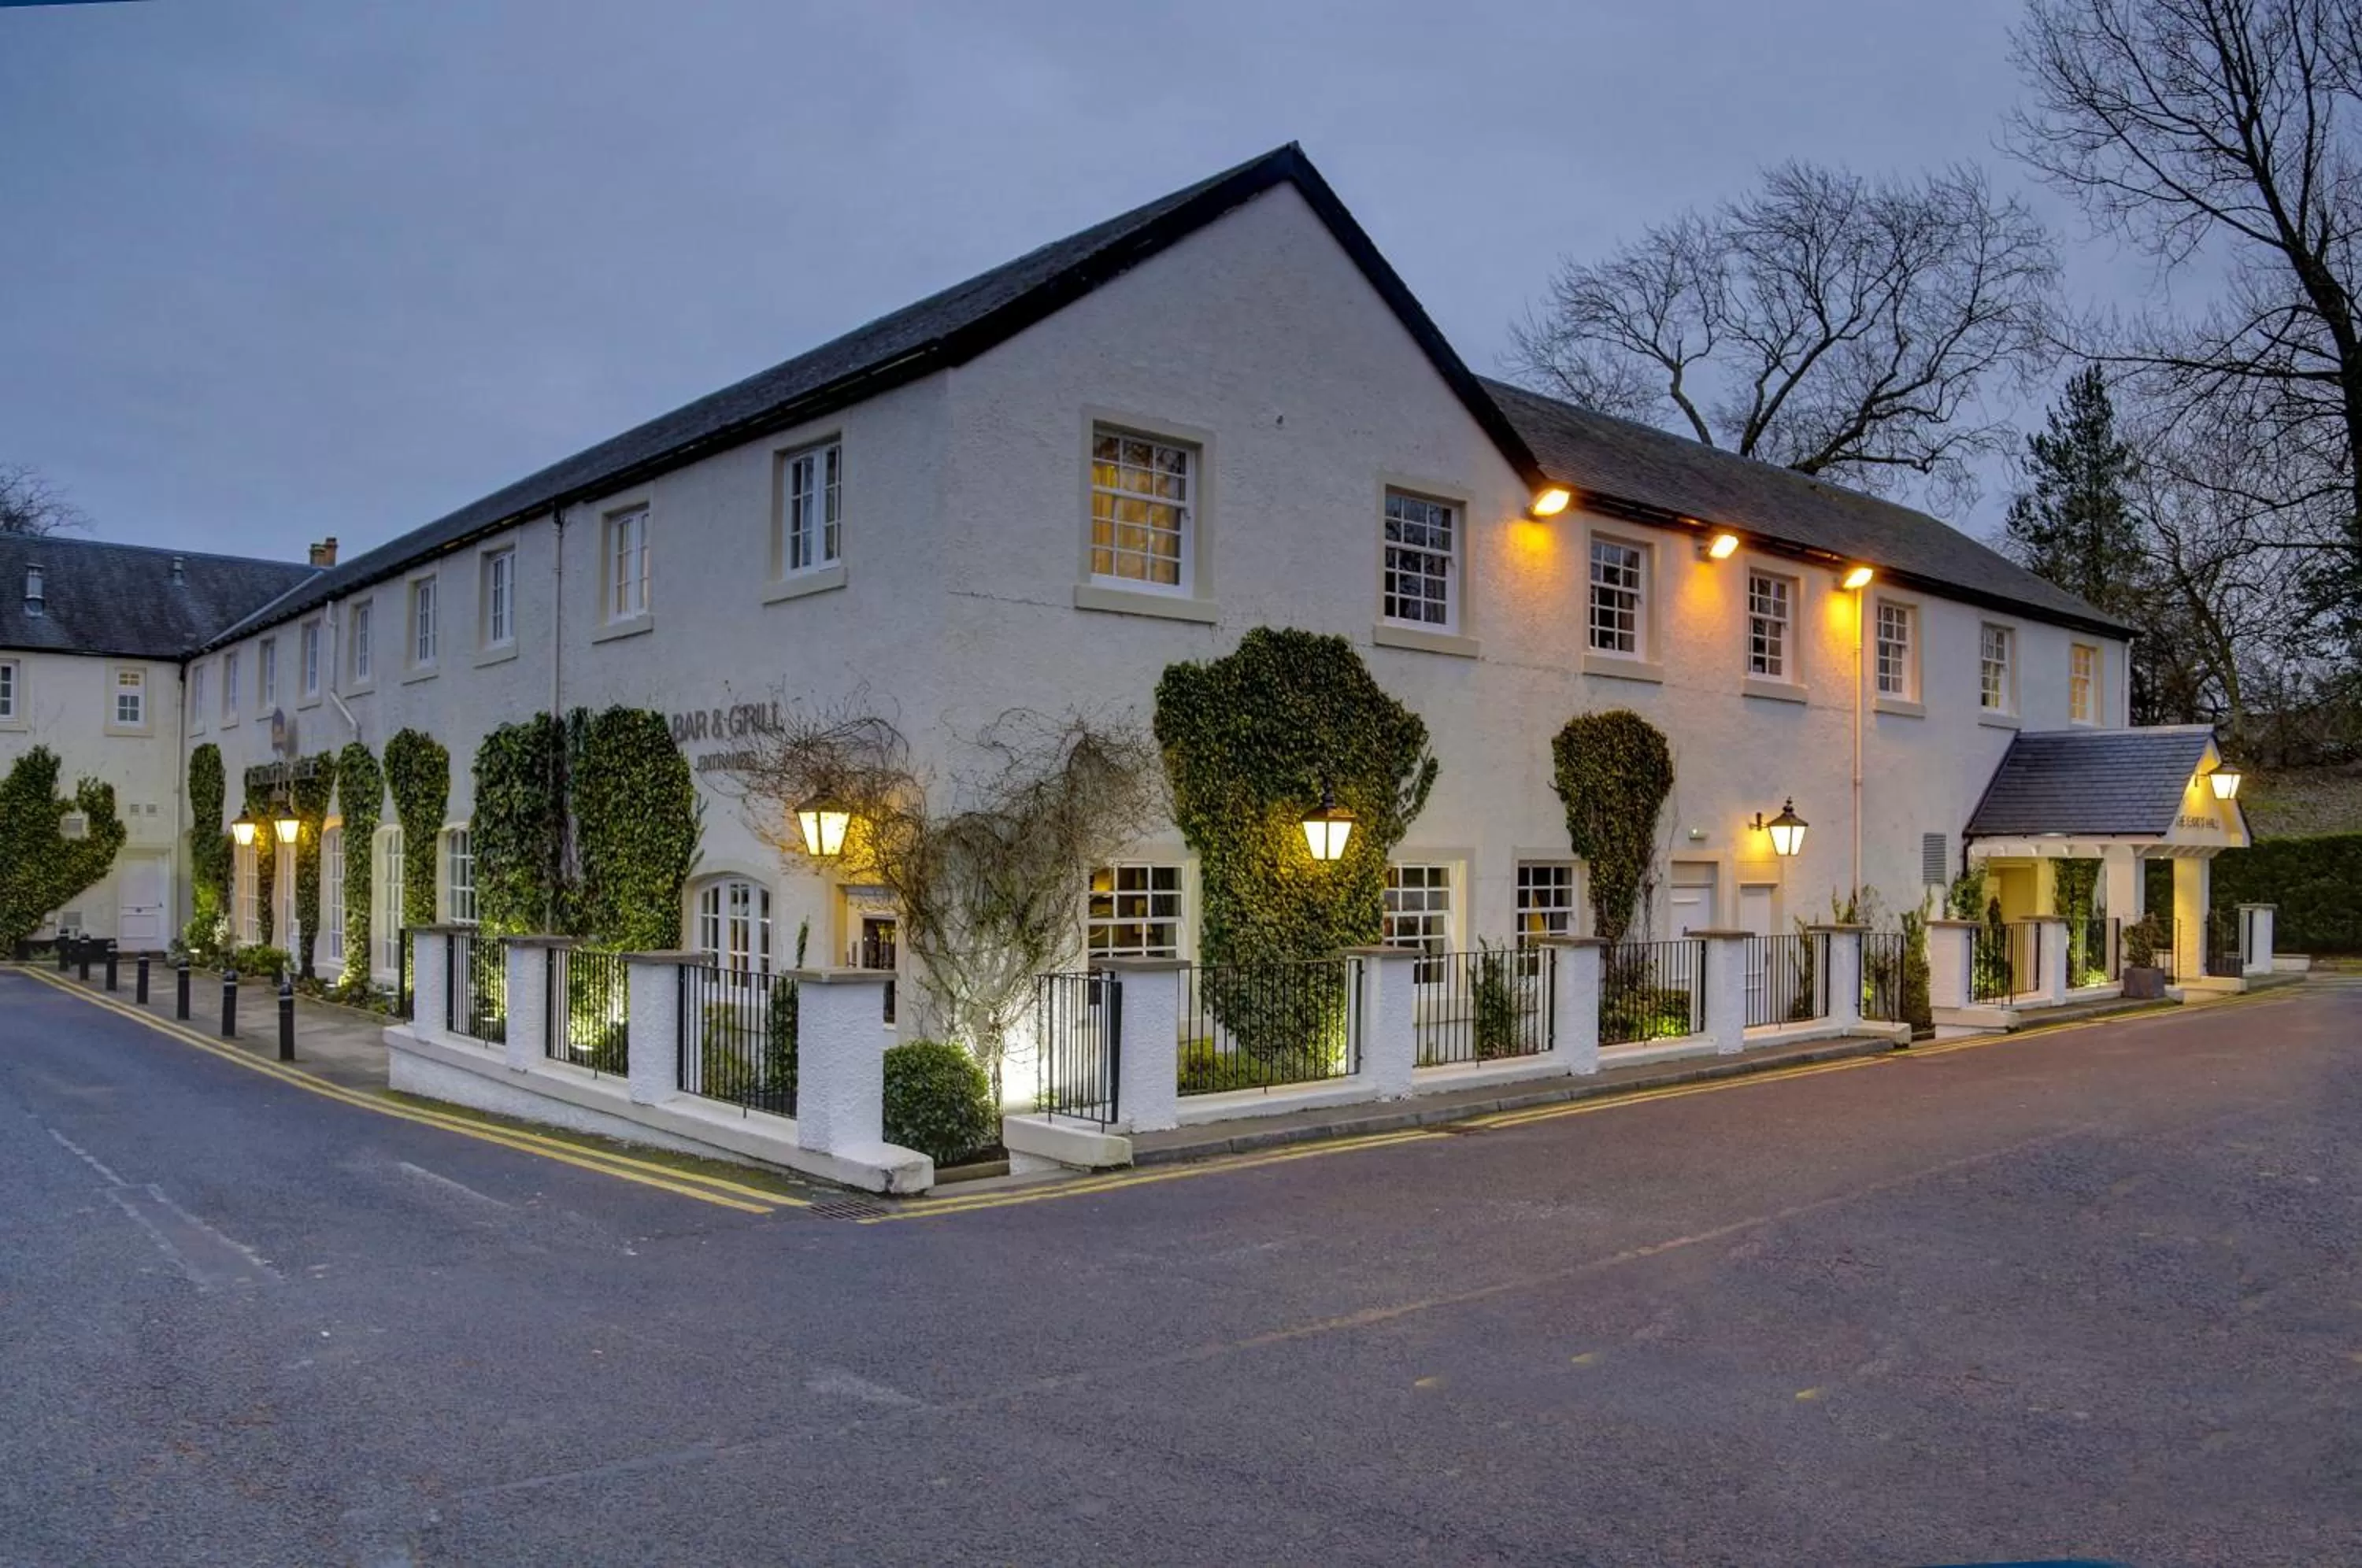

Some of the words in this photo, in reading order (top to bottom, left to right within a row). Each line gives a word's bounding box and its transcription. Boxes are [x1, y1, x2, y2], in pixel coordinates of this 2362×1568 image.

[672, 710, 708, 742] BAR
[711, 708, 724, 739] &
[729, 701, 785, 737] GRILL
